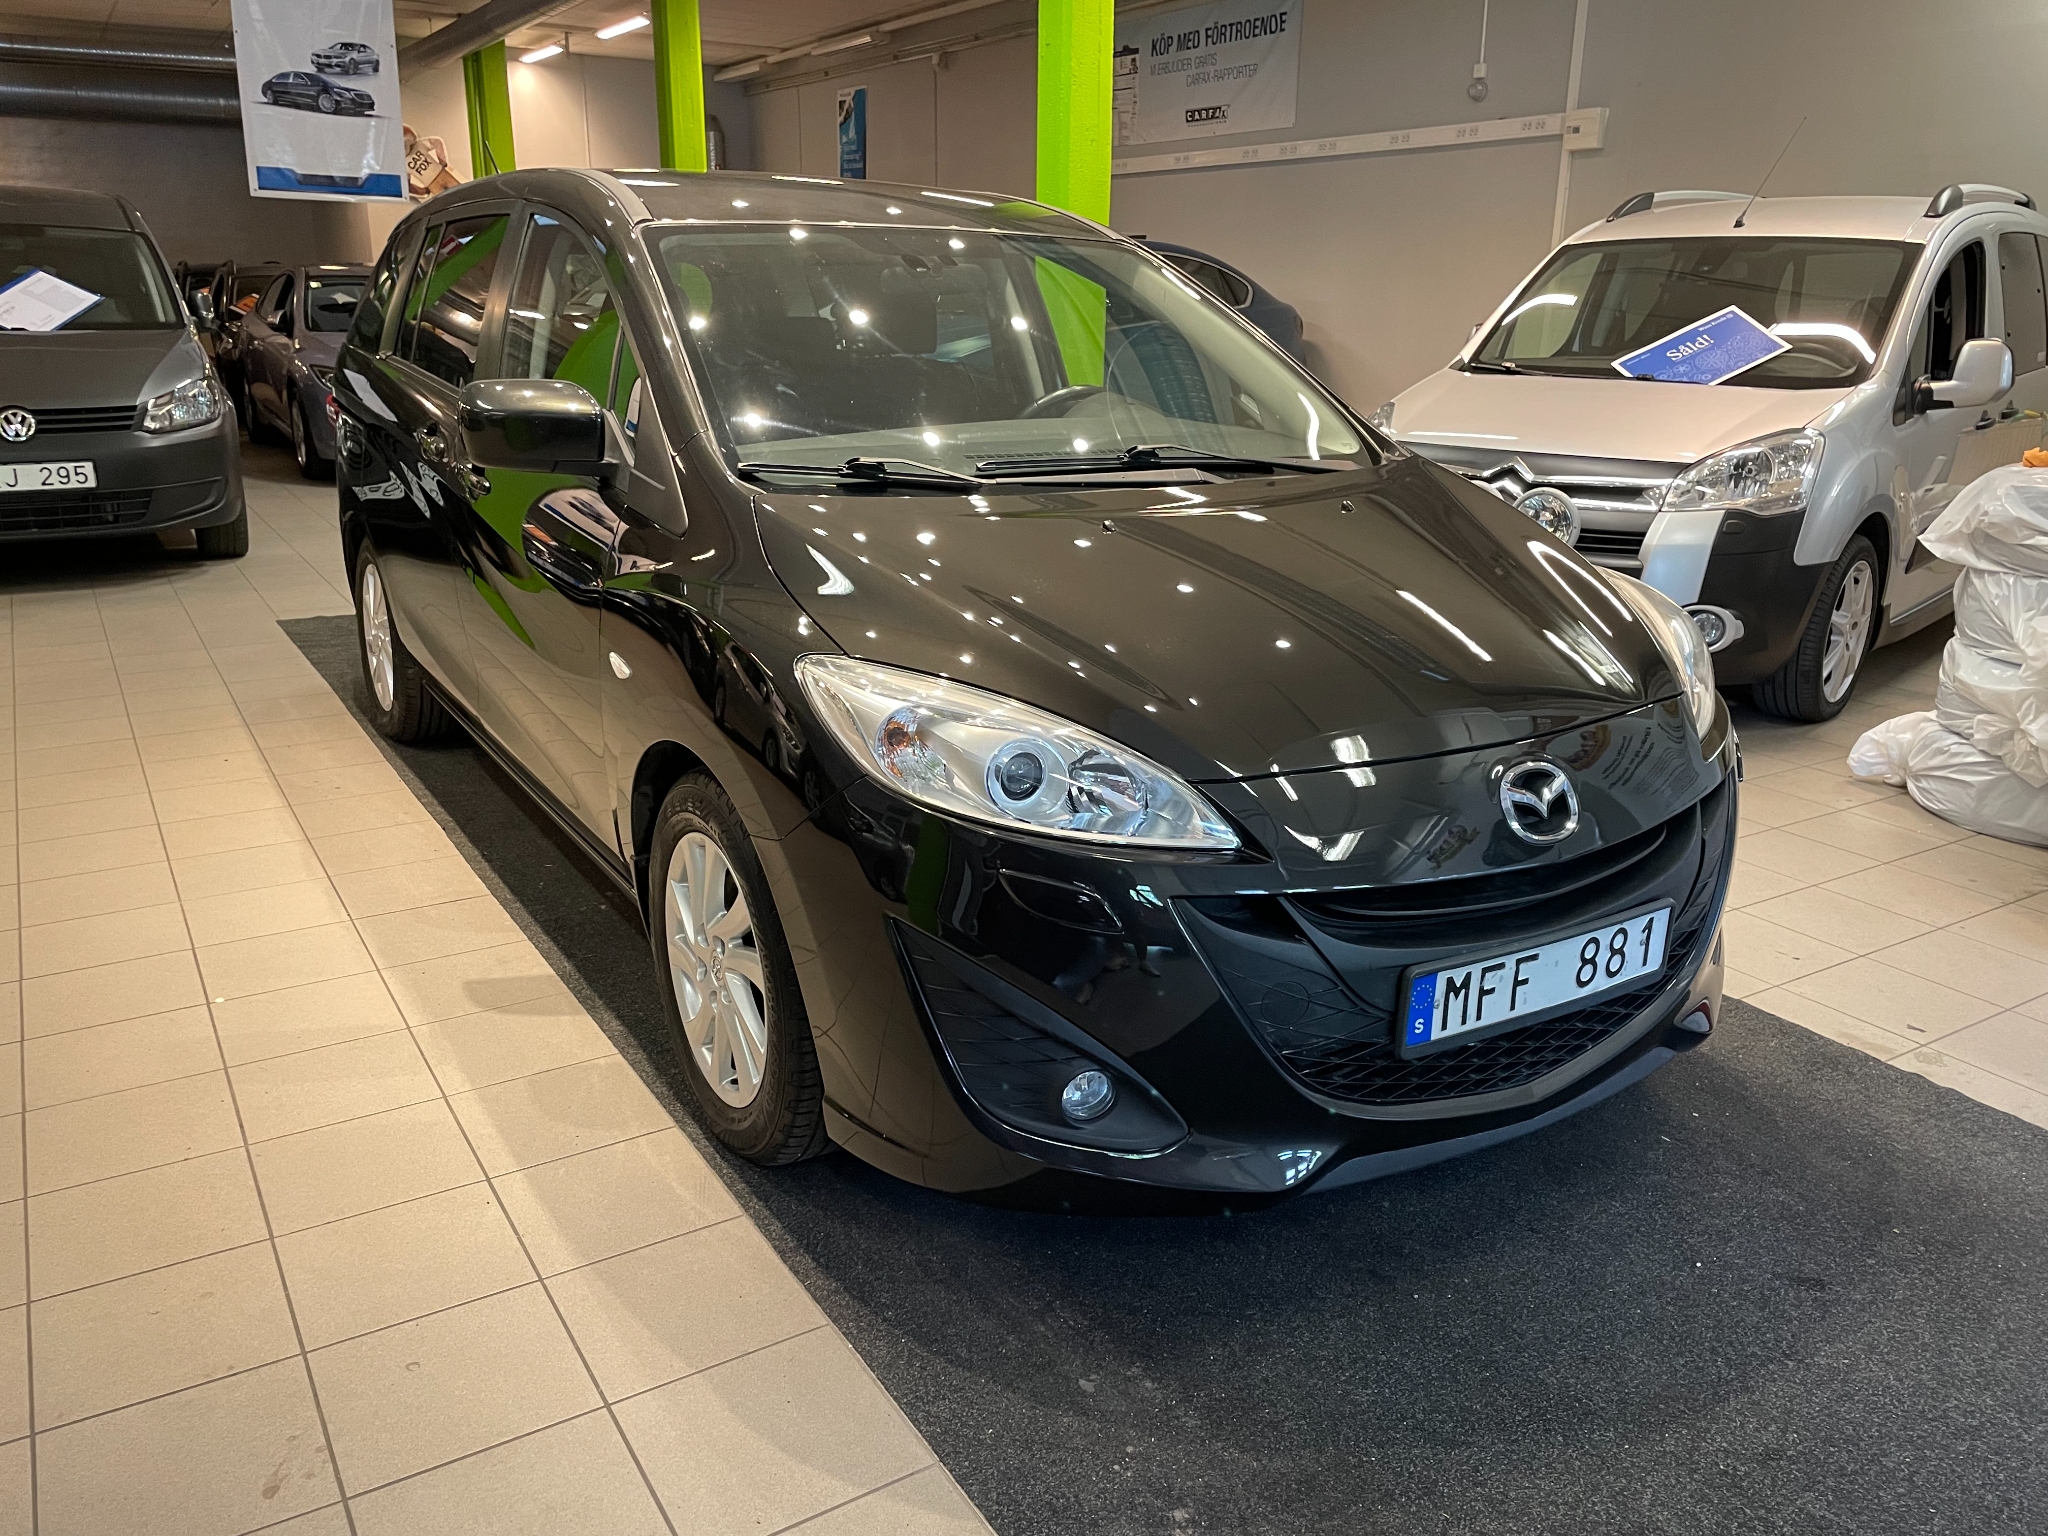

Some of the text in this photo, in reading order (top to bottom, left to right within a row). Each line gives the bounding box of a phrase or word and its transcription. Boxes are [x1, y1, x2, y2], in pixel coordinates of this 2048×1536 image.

[1151, 12, 1288, 57] KÖP MED FÖRTROENDE
[1194, 52, 1218, 70] GRATIS
[1186, 106, 1229, 123] CARFAX
[407, 150, 425, 170] CAR
[415, 157, 433, 176] FOX
[1666, 334, 1715, 362] Såld!
[0, 464, 89, 488] J 295
[1440, 916, 1655, 1031] MFF 881
[1413, 1018, 1424, 1034] S
